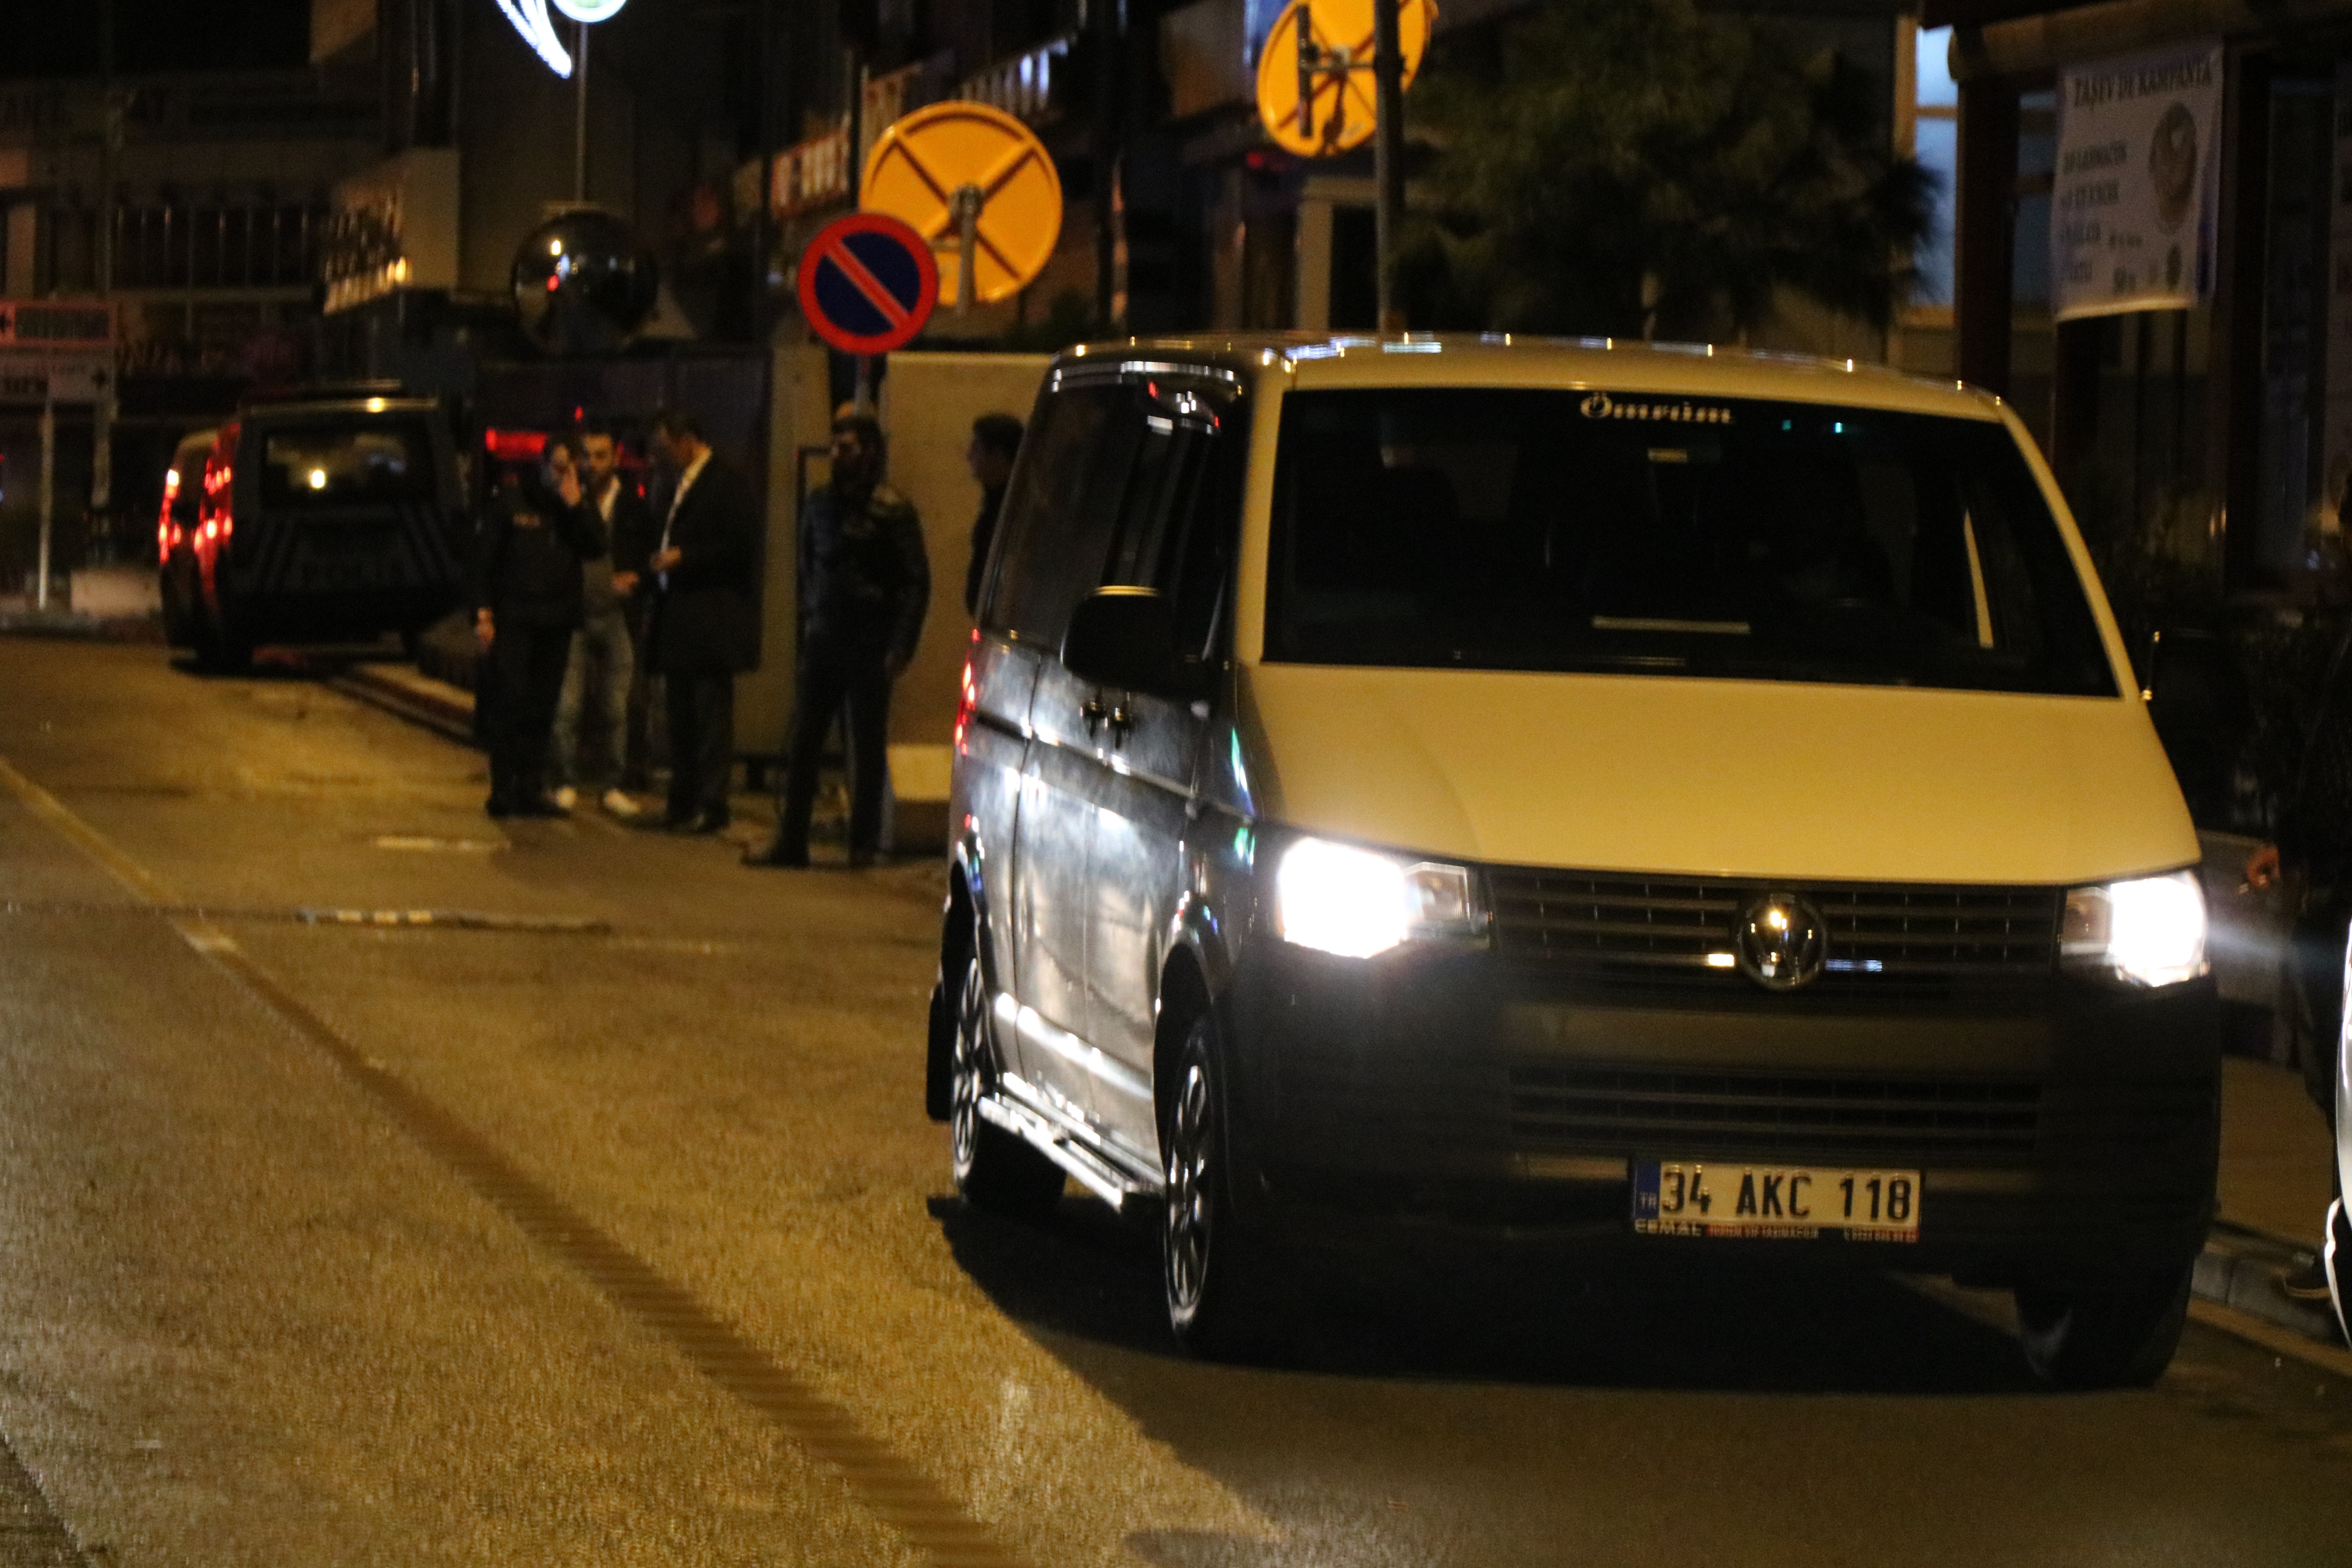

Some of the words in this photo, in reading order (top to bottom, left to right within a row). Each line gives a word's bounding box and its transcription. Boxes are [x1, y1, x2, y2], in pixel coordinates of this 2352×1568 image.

[1639, 1192, 1658, 1210] TR
[1663, 1164, 1711, 1214] 34
[1736, 1167, 1811, 1219] AKC
[1839, 1171, 1911, 1223] 118
